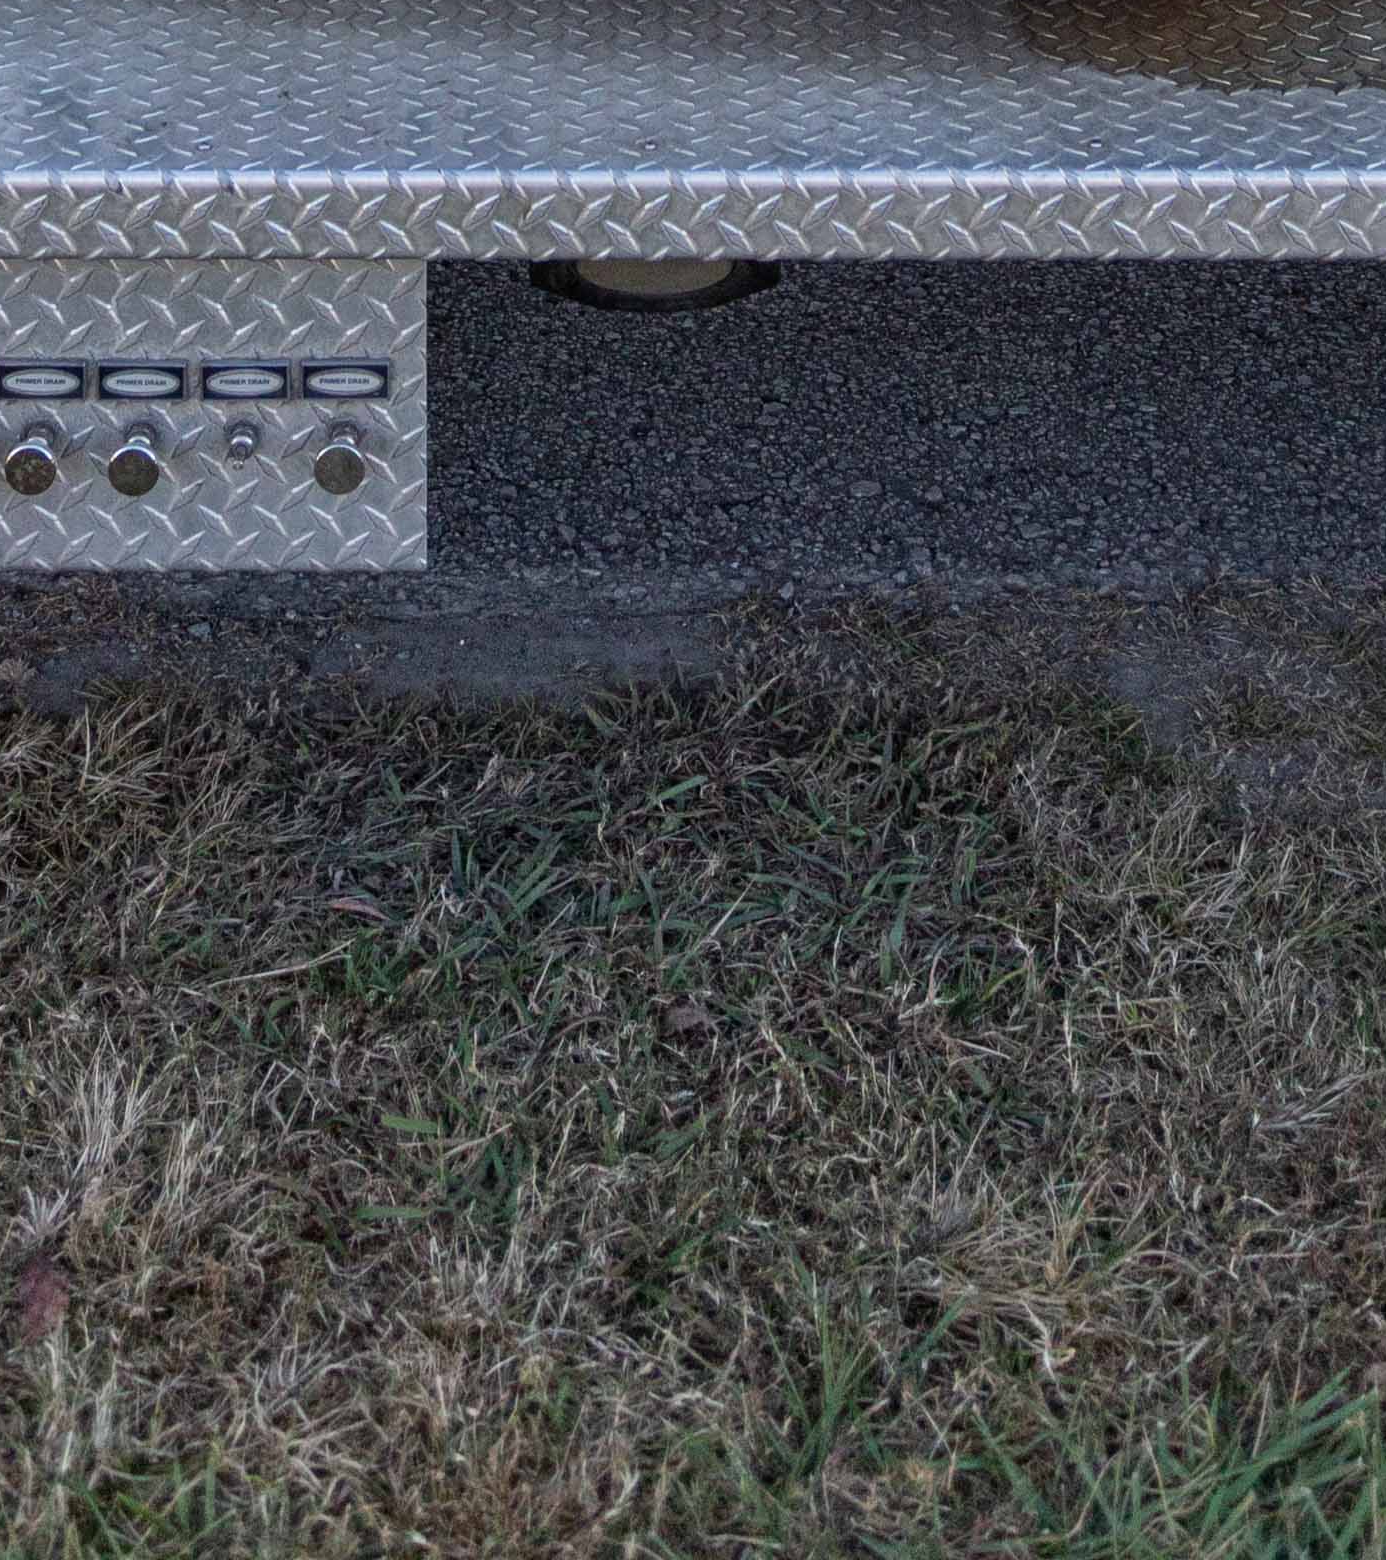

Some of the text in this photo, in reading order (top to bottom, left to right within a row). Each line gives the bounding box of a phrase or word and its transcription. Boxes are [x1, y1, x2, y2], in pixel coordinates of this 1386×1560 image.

[15, 376, 67, 386] PRIMER DRAIN
[116, 377, 167, 387] PRIMER DRAIN
[219, 377, 271, 386] PRIMER DRAIN
[319, 376, 370, 385] PRIMER DRAIN
